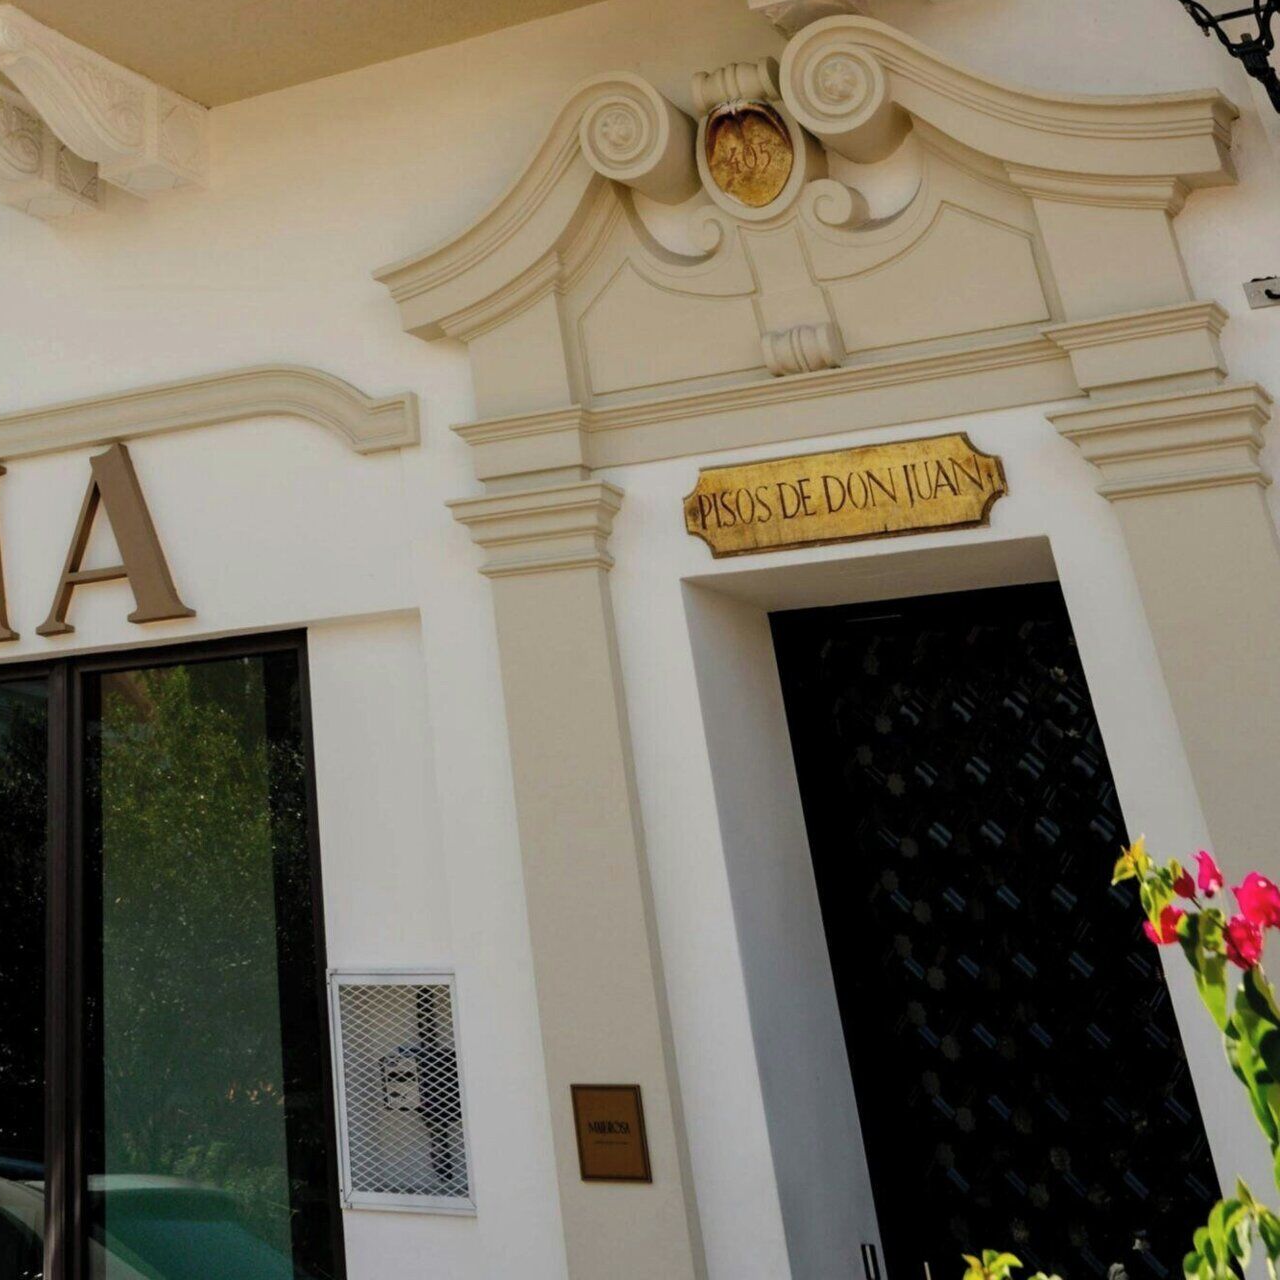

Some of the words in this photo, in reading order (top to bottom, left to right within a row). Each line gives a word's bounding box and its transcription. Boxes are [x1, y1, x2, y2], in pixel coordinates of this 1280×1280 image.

[724, 140, 772, 175] 405
[697, 485, 773, 531] PISOS
[776, 477, 817, 520] DE
[821, 466, 899, 514] DON
[902, 453, 986, 509] JUAN
